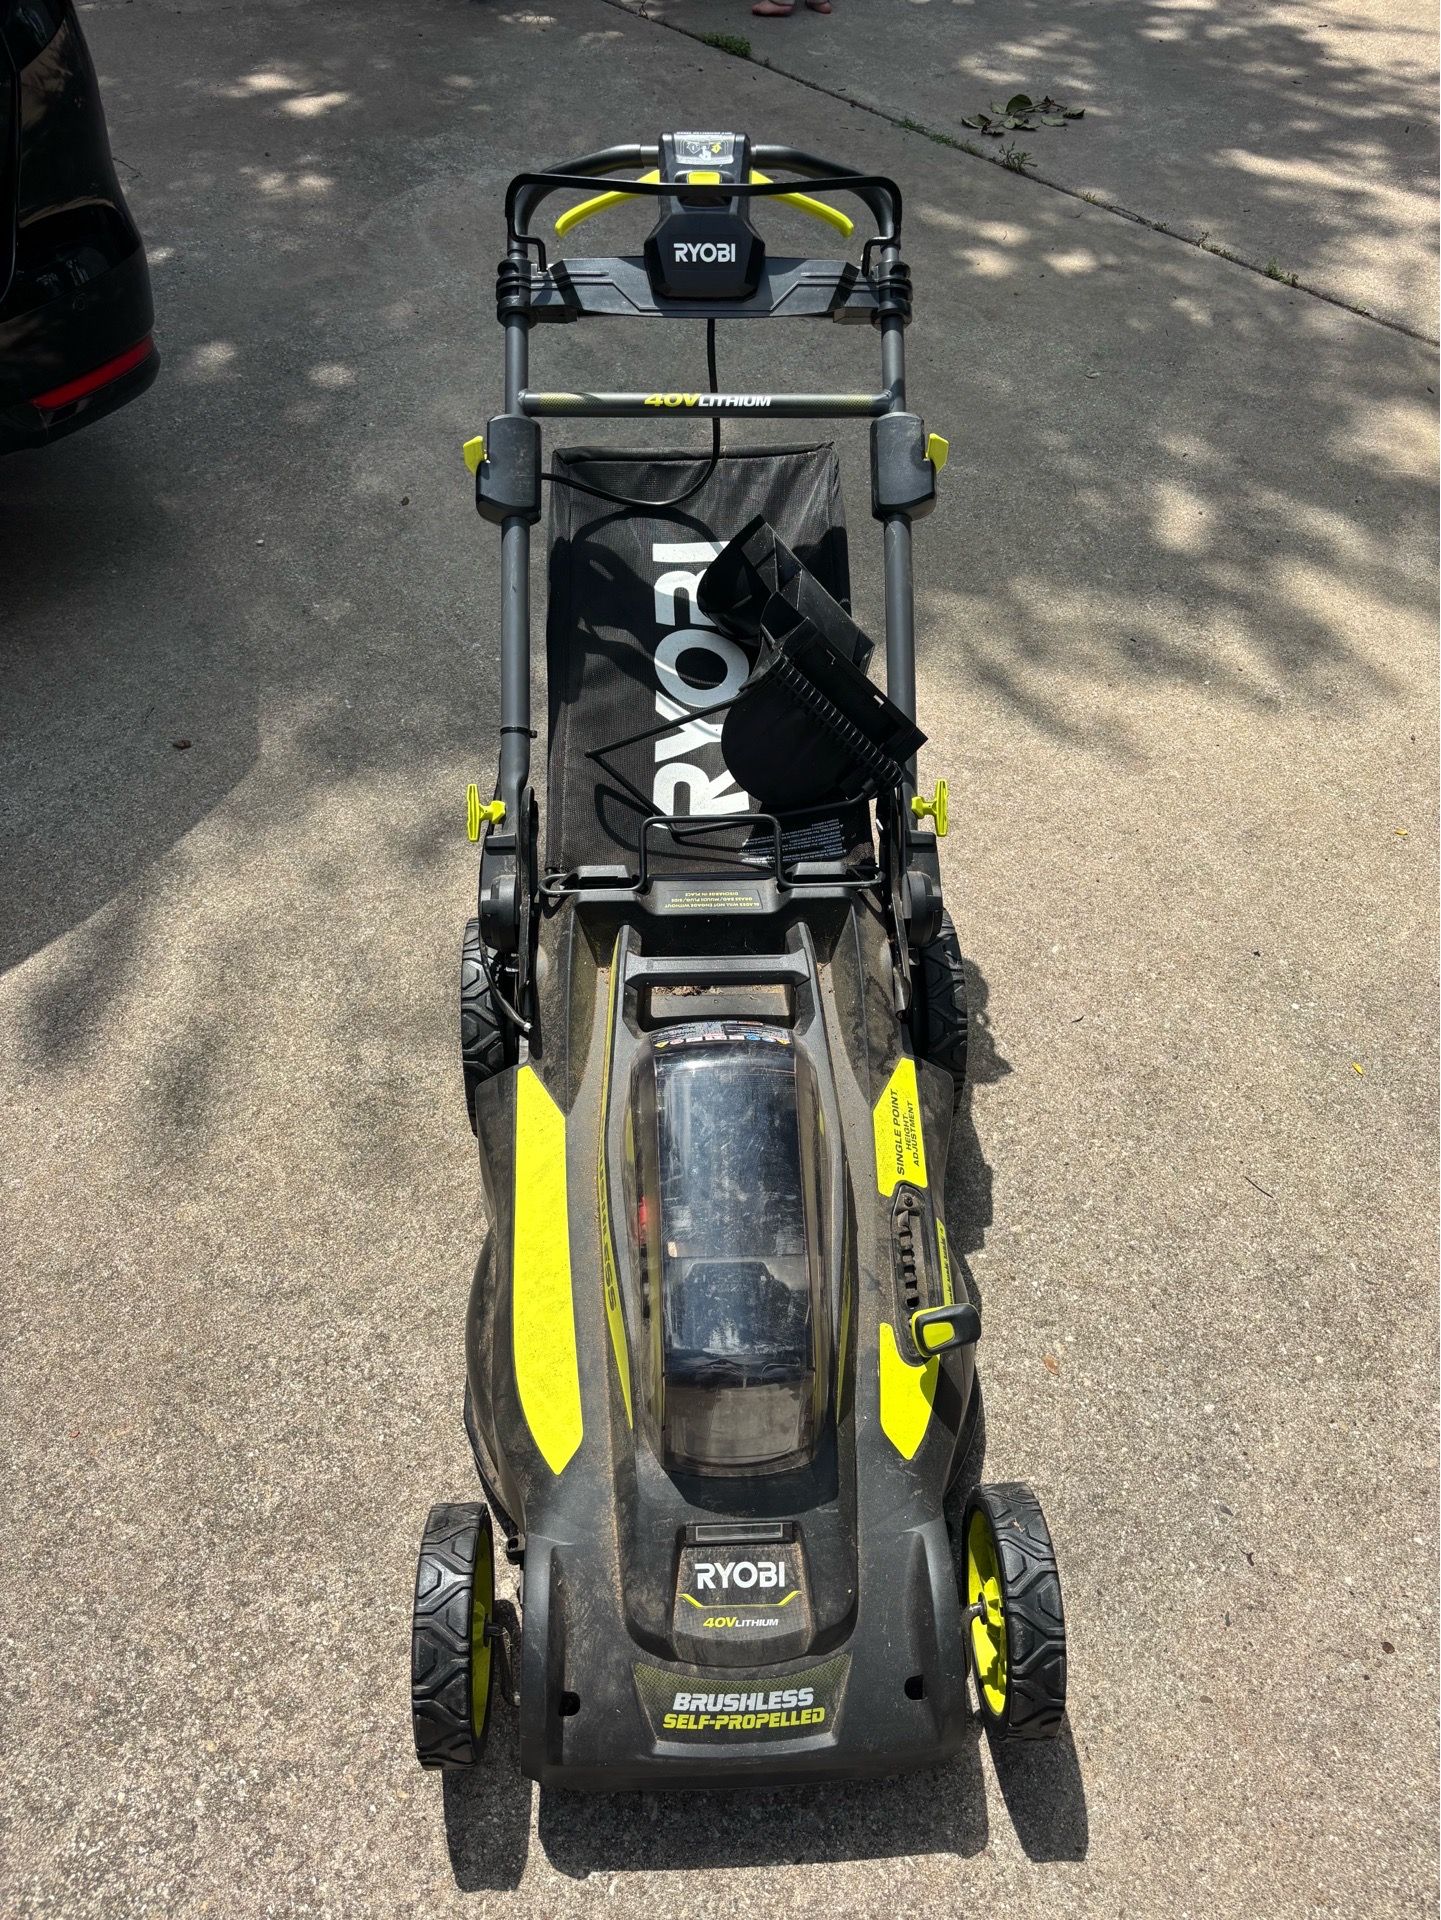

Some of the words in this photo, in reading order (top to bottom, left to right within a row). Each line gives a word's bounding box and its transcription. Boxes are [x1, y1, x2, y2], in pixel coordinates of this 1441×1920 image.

[673, 242, 736, 263] RYOBI
[890, 1089, 901, 1127] POINT
[902, 1114, 912, 1151] HEIGHT
[906, 1100, 920, 1167] ADJUSTMENT
[894, 1130, 905, 1175] SINGLE
[694, 1561, 786, 1590] RYOBI
[672, 1687, 815, 1712] BRUSHLESS
[662, 1706, 827, 1730] SELF-PROPELLED
